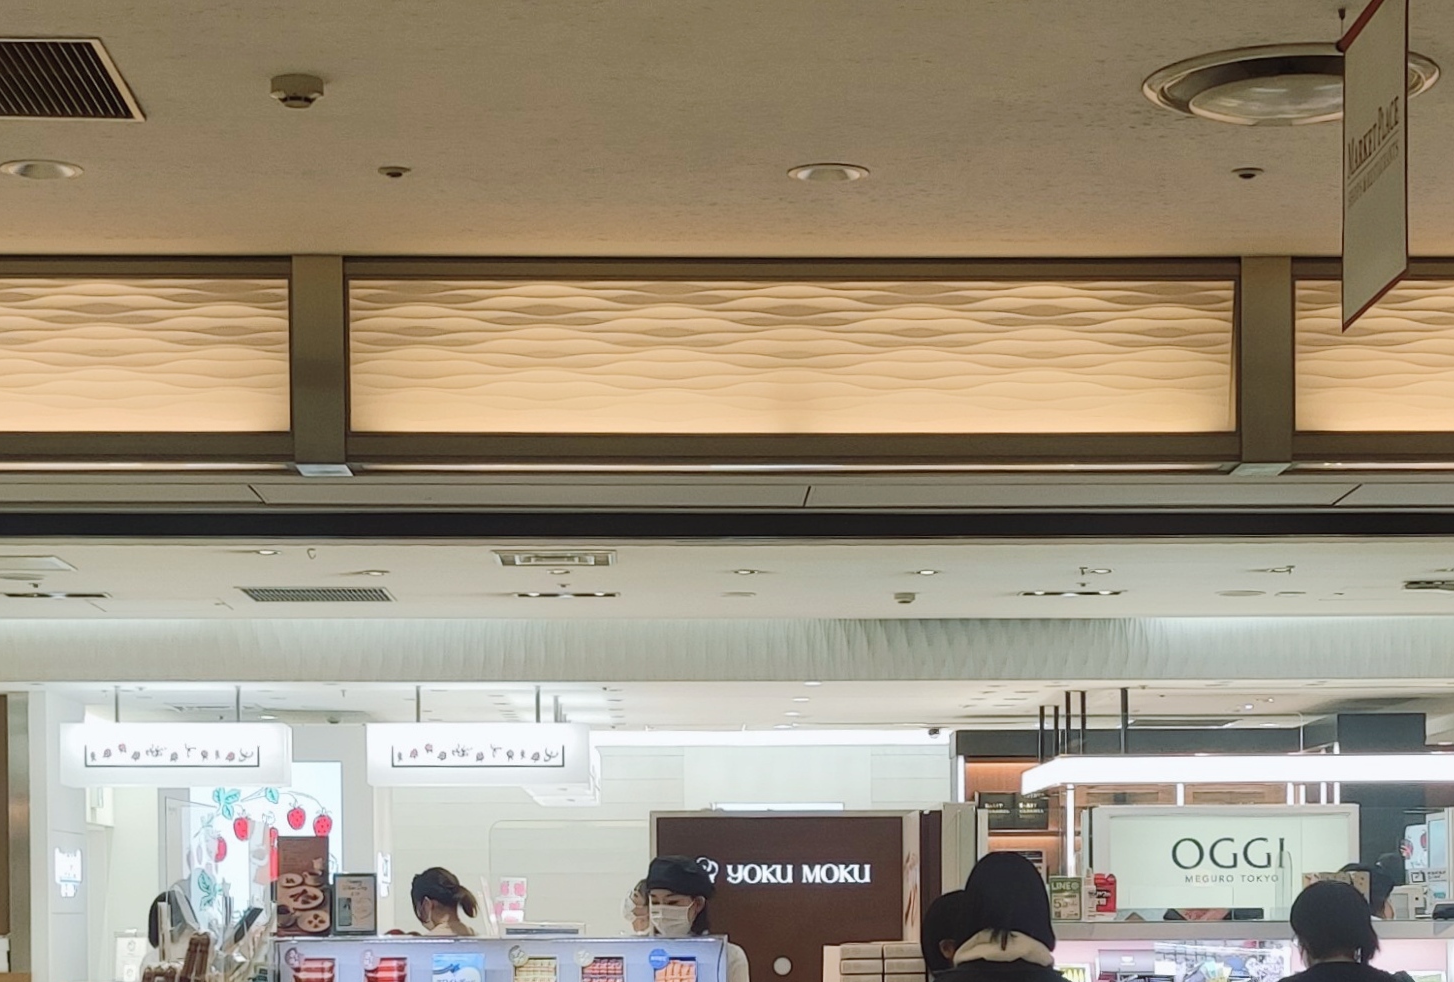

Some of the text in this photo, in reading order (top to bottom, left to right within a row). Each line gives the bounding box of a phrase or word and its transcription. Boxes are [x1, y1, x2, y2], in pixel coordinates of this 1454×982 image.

[1171, 837, 1285, 870] OGGI
[726, 863, 871, 884] YOKU MOKU
[1185, 874, 1279, 883] MEGURO TOKYO
